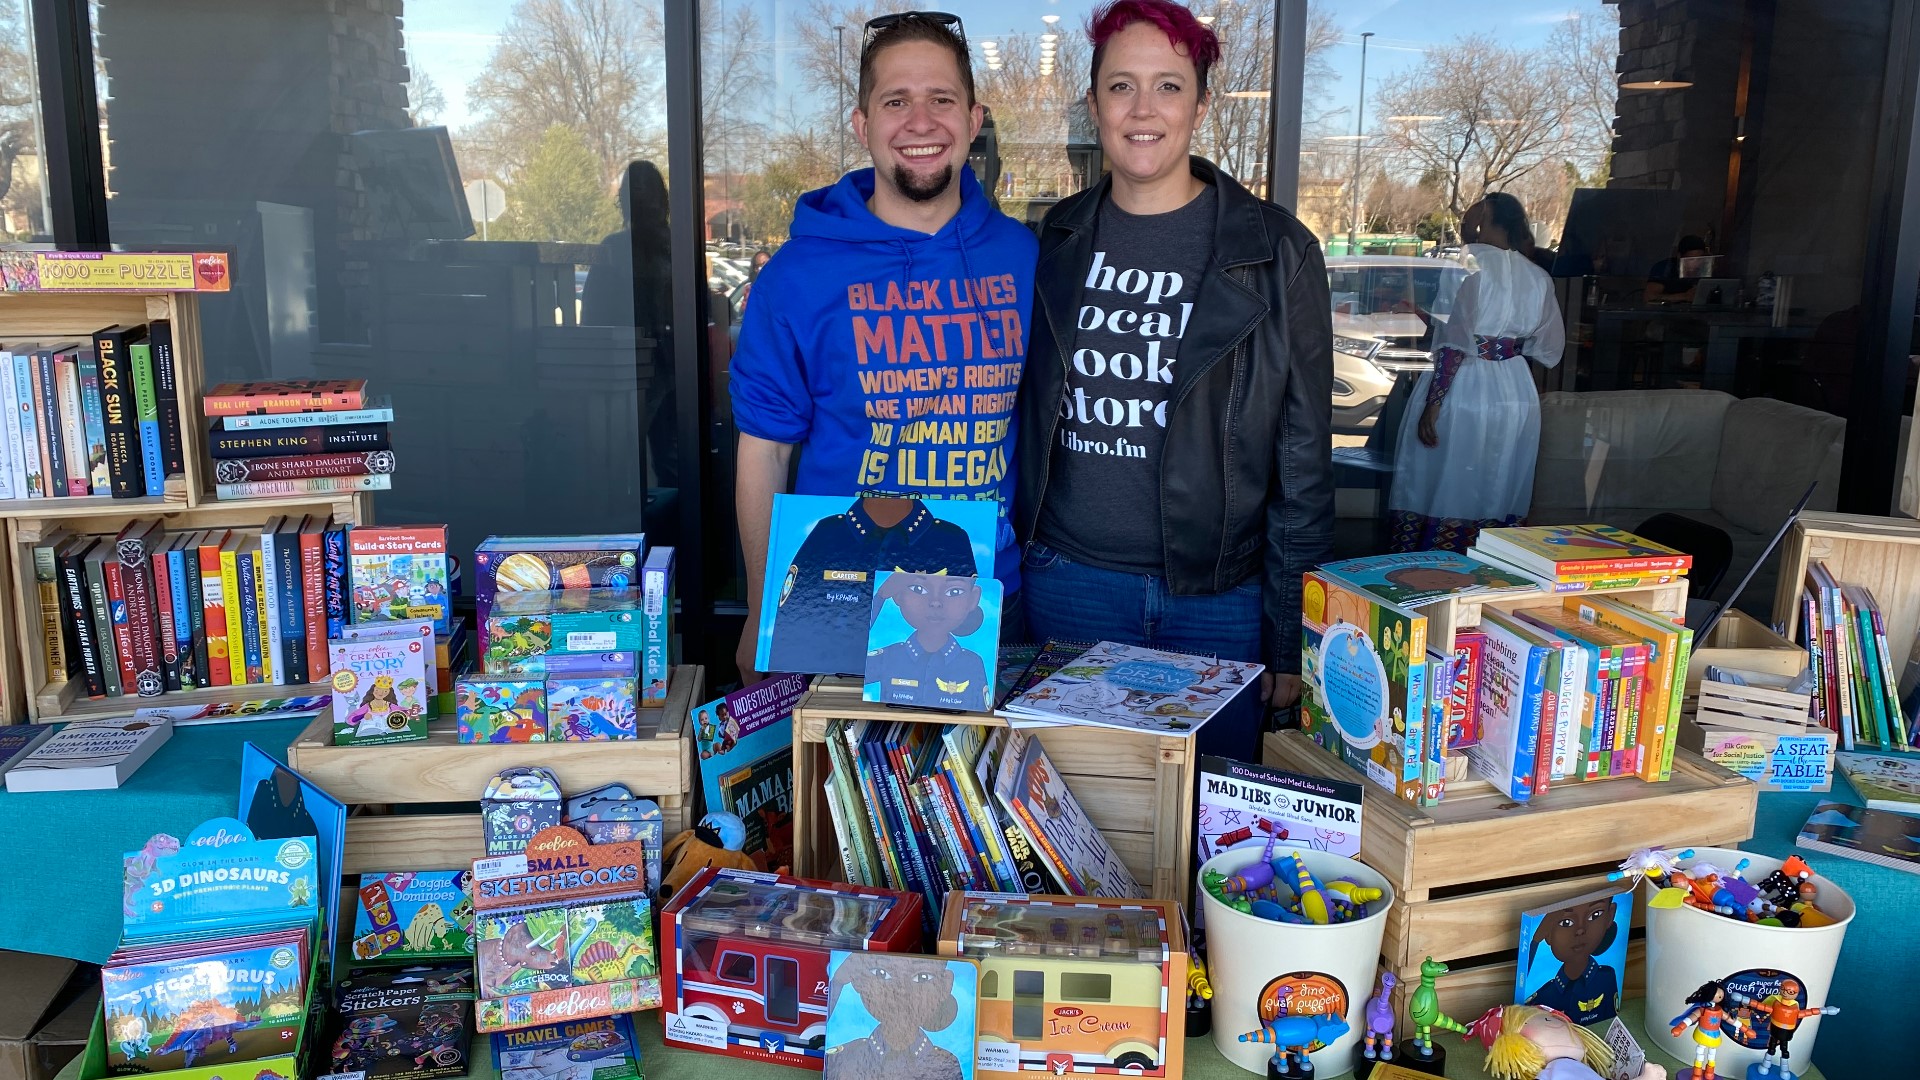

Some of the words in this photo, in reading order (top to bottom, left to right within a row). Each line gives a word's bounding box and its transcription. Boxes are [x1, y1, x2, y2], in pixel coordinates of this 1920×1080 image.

[42, 263, 89, 279] 1000
[120, 264, 192, 279] PUZZLE
[1085, 251, 1183, 304] hop
[848, 279, 944, 311] BLACK
[950, 274, 1016, 309] LIVES
[1077, 302, 1194, 339] ocal
[851, 309, 1024, 364] MATTER
[99, 339, 118, 389] BLACK
[1073, 341, 1176, 384] ook
[2, 357, 12, 399] Cleanness
[858, 366, 958, 394] WOMEN'S
[965, 363, 1022, 389] RIGHTS
[106, 394, 122, 424] SUN
[264, 399, 300, 407] BRANDON
[304, 398, 333, 406] TAYLOR
[865, 399, 900, 419] ARE
[906, 395, 966, 418] HUMAN
[972, 391, 1017, 415] RIGHTS
[8, 407, 16, 432] Garth
[119, 433, 127, 463] REBECCA
[220, 439, 271, 448] STEPHEN
[278, 437, 308, 445] KING
[329, 434, 377, 443] INSTITUTE
[870, 422, 893, 447] NO
[897, 421, 967, 445] HUMAN
[1061, 428, 1147, 459] Libro.fm
[11, 434, 22, 472] Greenwell
[110, 433, 120, 476] ROANHORSE
[255, 462, 278, 470] BONE
[282, 460, 312, 469] SHARD
[315, 457, 362, 467] DAUGHTER
[857, 449, 889, 485] IS
[268, 469, 306, 478] ANDREA
[310, 466, 351, 475] STEWART
[258, 482, 294, 493] ARGENTINA
[354, 542, 413, 551] Build-a-Story
[415, 541, 442, 549] Cards
[240, 558, 251, 587] Written
[264, 540, 272, 576] MARGARET
[268, 580, 276, 609] ATWOOD
[285, 558, 293, 590] DOCTOR
[312, 546, 321, 576] ELENA
[489, 553, 504, 578] JUPITER
[66, 568, 82, 610] EARTHLINGS
[91, 582, 102, 605] open
[97, 607, 106, 620] me
[315, 576, 323, 615] FERRANTE
[127, 583, 135, 619] ANDREA
[132, 621, 143, 658] STEWART
[138, 596, 148, 624] SHARD
[288, 600, 296, 627] ALEPPO
[118, 628, 128, 648] Life
[649, 614, 661, 642] obal
[77, 619, 88, 646] SAYAKA
[83, 648, 95, 675] MURATA
[122, 649, 129, 659] of
[142, 625, 154, 668] DAUGHTER
[351, 652, 393, 660] CREATE
[648, 646, 662, 674] Kids
[1484, 636, 1517, 664] crubbing
[125, 660, 134, 671] Pi
[351, 658, 406, 672] STORY
[360, 669, 400, 677] CARDS
[1116, 667, 1194, 683] DRAW
[1410, 672, 1422, 704] Who's
[1560, 669, 1575, 717] SNUGGLE
[241, 704, 306, 714] Grove
[752, 705, 776, 720] WASHABLE
[761, 714, 776, 724] PROOF
[58, 731, 148, 740] AMERICANAH
[1545, 714, 1556, 733] FIRST
[1555, 719, 1569, 756] PUPPY!
[1607, 710, 1616, 750] EXPLORER
[36, 747, 77, 755] NGOZI
[46, 739, 137, 748] CHIMAMANDA
[1542, 737, 1553, 766] LADIES
[1775, 744, 1785, 755] A
[1789, 744, 1828, 756] SEAT
[1231, 766, 1244, 775] 100
[1245, 769, 1258, 778] Days
[1267, 773, 1286, 784] School
[1303, 781, 1315, 789] Libs
[1316, 783, 1335, 794] Junior
[1773, 765, 1825, 777] TABLE
[736, 773, 784, 819] MAMA
[1207, 779, 1237, 797] MAD
[1241, 786, 1271, 805] LIBS
[1292, 799, 1356, 823] JUNIOR
[1011, 824, 1030, 858] STAR
[1030, 821, 1043, 837] PAPER
[1045, 792, 1078, 866] Paper
[1005, 827, 1024, 861] WARS
[528, 854, 589, 873] SMALL
[151, 879, 175, 896] 3D
[179, 868, 291, 888] DINOSAURS
[410, 878, 451, 890] Doggie
[480, 865, 638, 898] SKETCHBOOKS
[393, 890, 455, 902] Dominoes
[345, 990, 384, 1000] Scratch
[386, 988, 417, 996] Paper
[510, 974, 569, 991] SKETCHBOOK
[1300, 983, 1325, 996] dino
[1727, 982, 1755, 993] push
[340, 996, 421, 1013] Stickers
[1265, 995, 1293, 1011] push
[1296, 993, 1340, 1013] puppets
[281, 1031, 293, 1039] 5+
[505, 1028, 562, 1046] TRAVEL
[565, 1020, 615, 1037] GAMES
[1049, 1019, 1073, 1037] Ice
[1078, 1016, 1131, 1034] Cream
